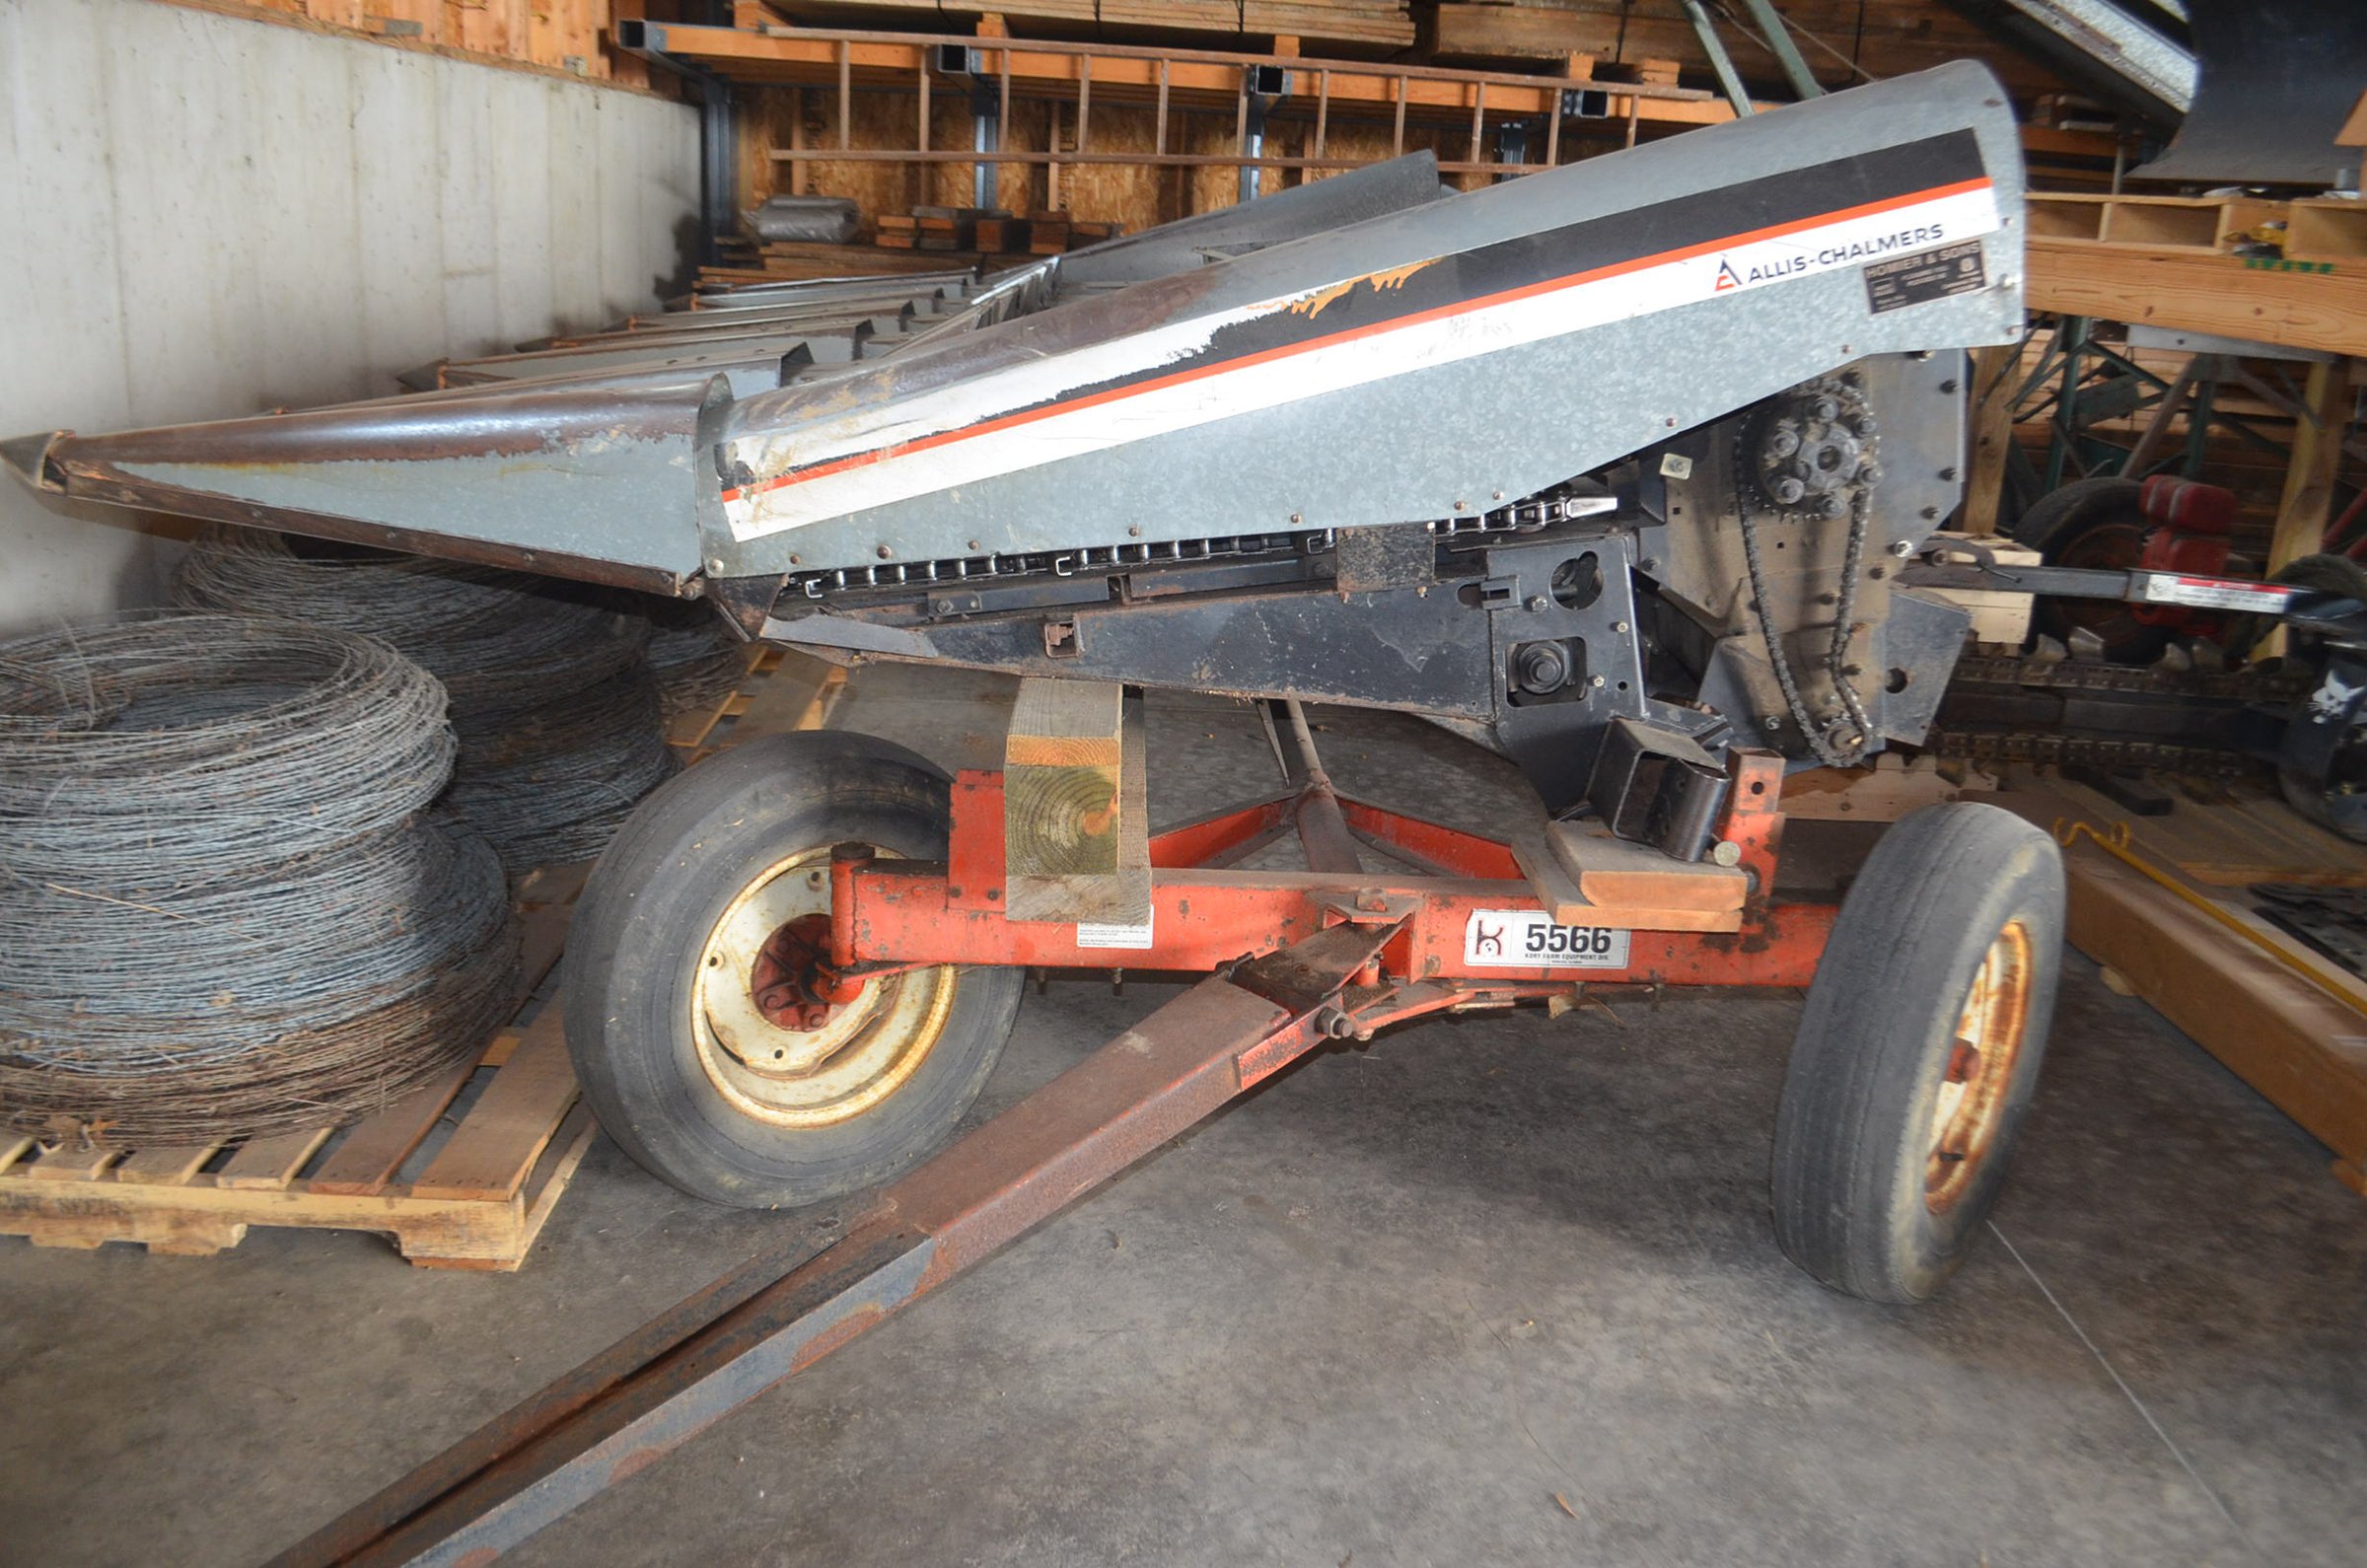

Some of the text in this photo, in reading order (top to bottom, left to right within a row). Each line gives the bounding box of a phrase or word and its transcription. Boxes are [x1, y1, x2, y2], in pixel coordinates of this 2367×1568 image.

[1749, 223, 1944, 283] ALLIS-CHALMERS
[1925, 252, 1937, 264] &
[1939, 242, 1981, 261] SONS
[1525, 923, 1612, 953] 5566
